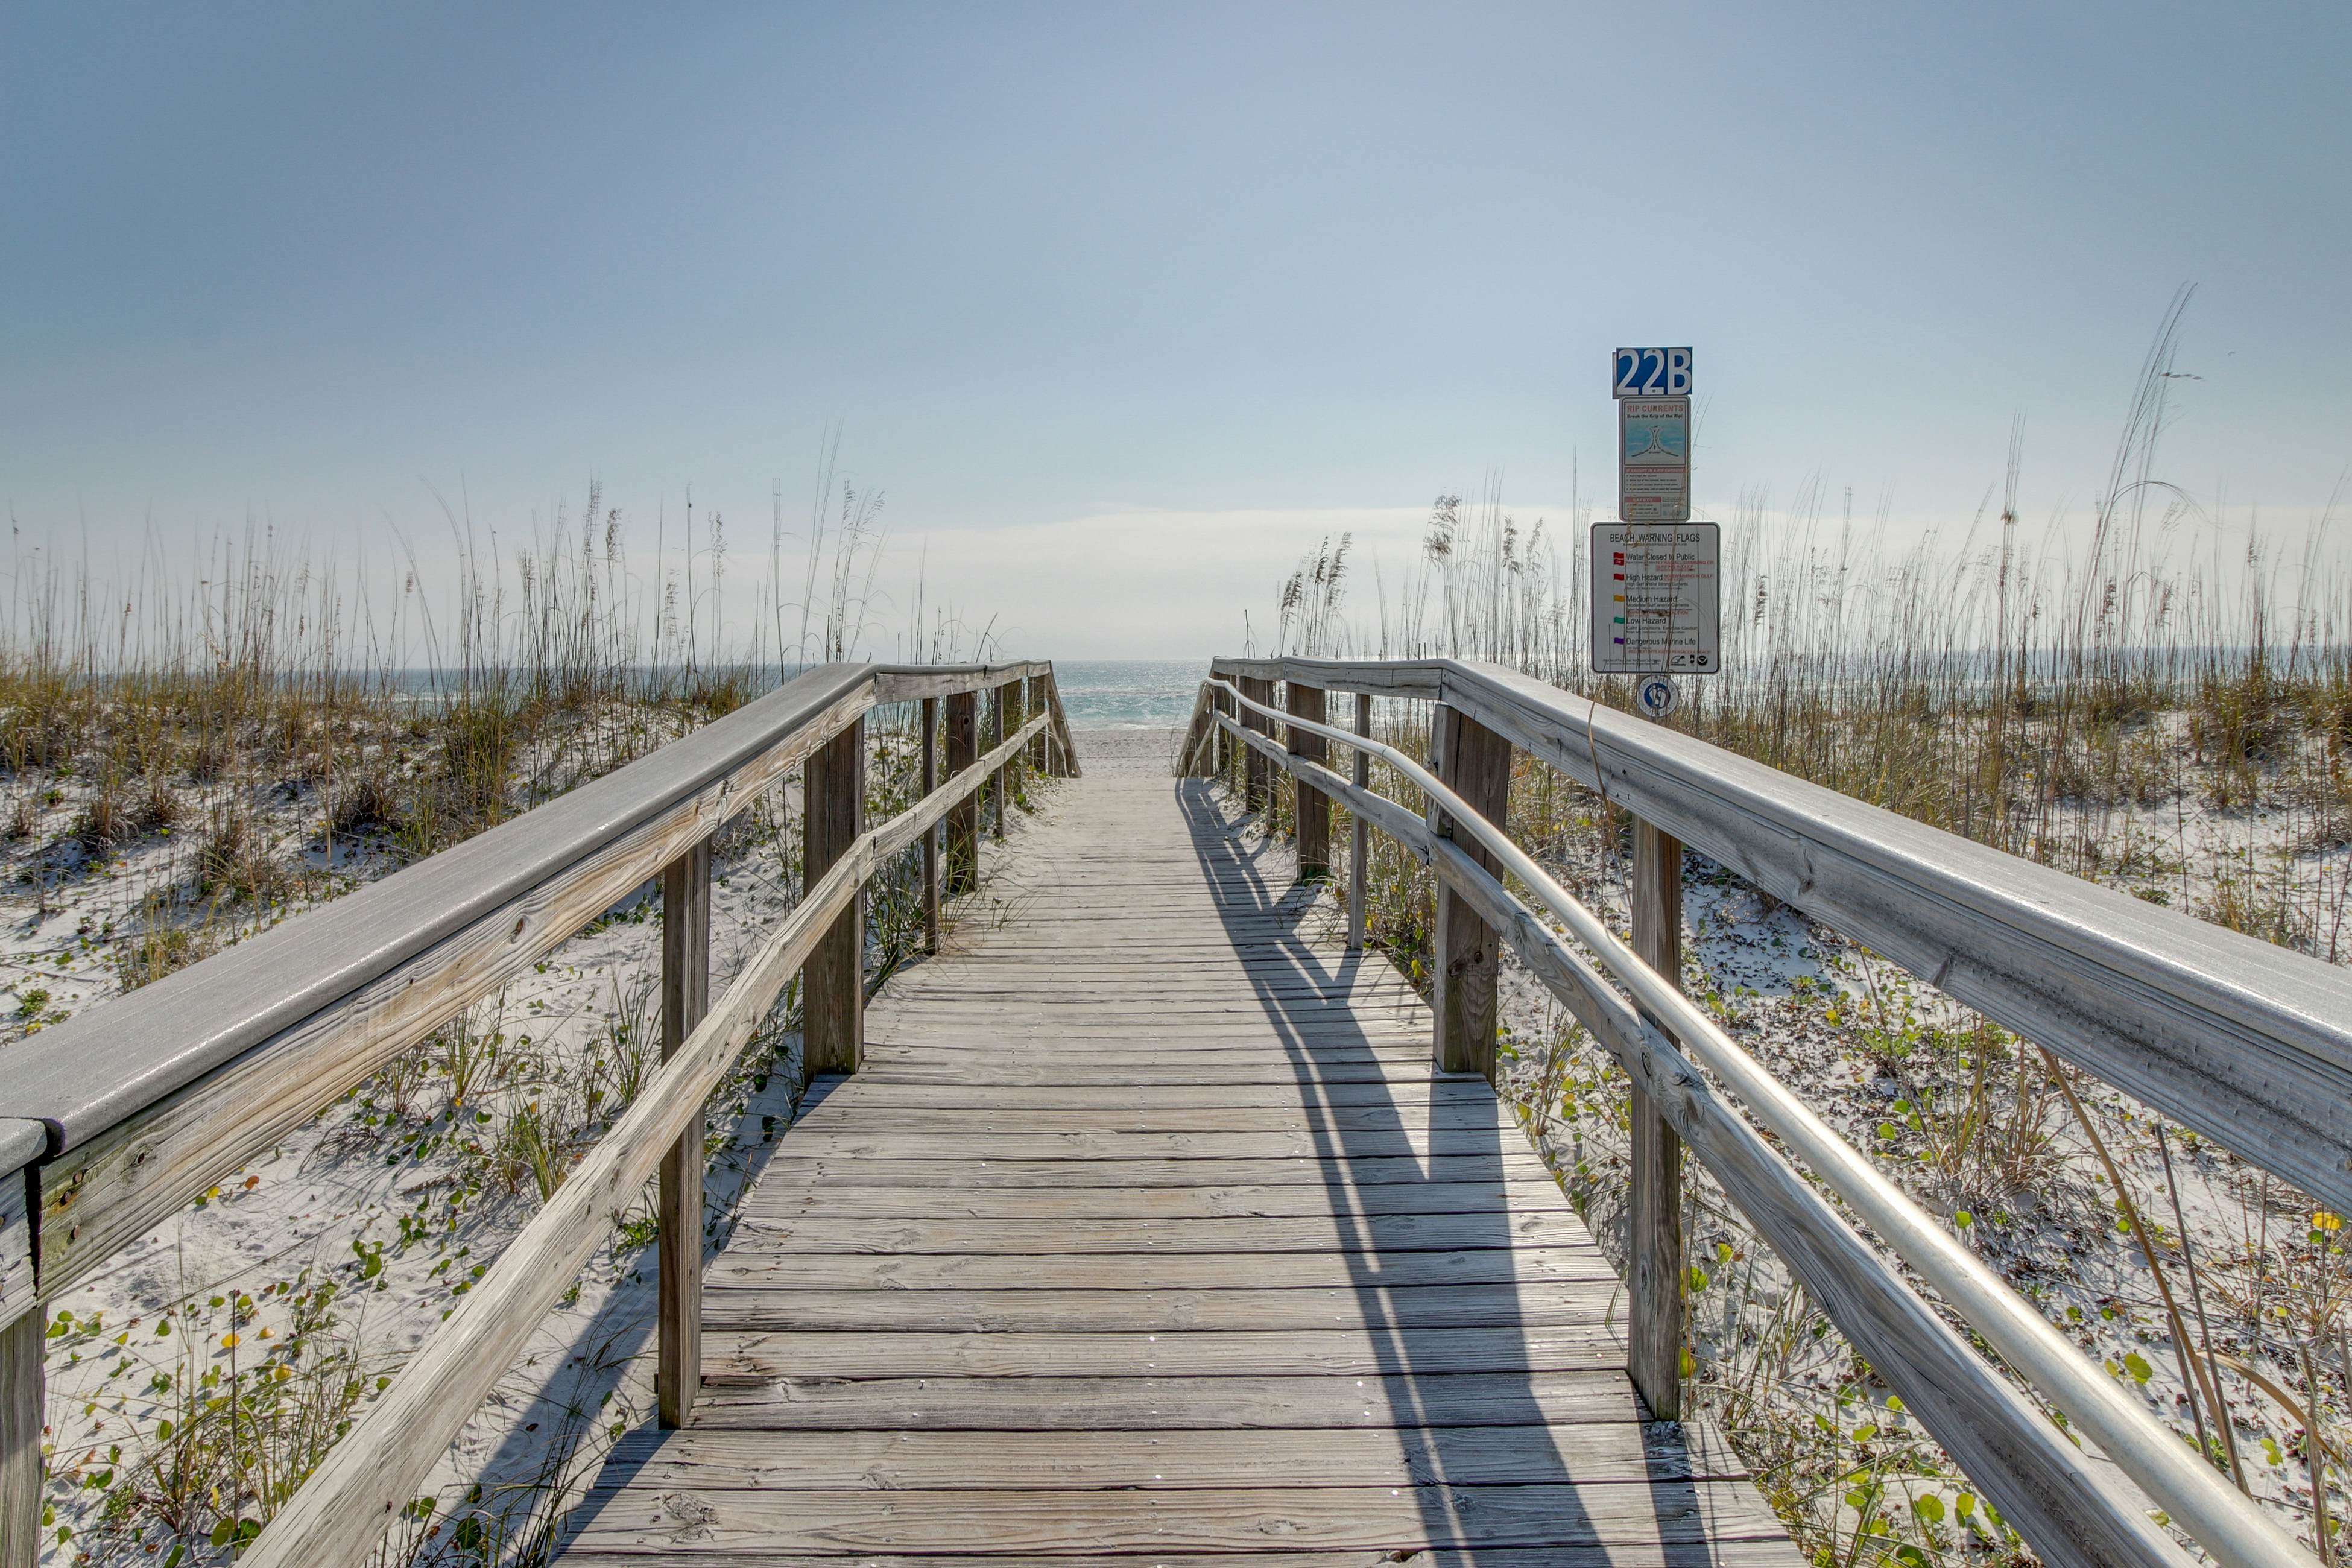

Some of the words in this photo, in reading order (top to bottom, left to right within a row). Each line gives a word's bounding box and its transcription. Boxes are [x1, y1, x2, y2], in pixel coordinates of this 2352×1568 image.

[1616, 348, 1692, 395] 22B
[1610, 533, 1634, 542] BEACH
[1639, 533, 1673, 542] WARNING
[1677, 533, 1700, 542] FLAGS
[1626, 638, 1660, 646] Dangerous
